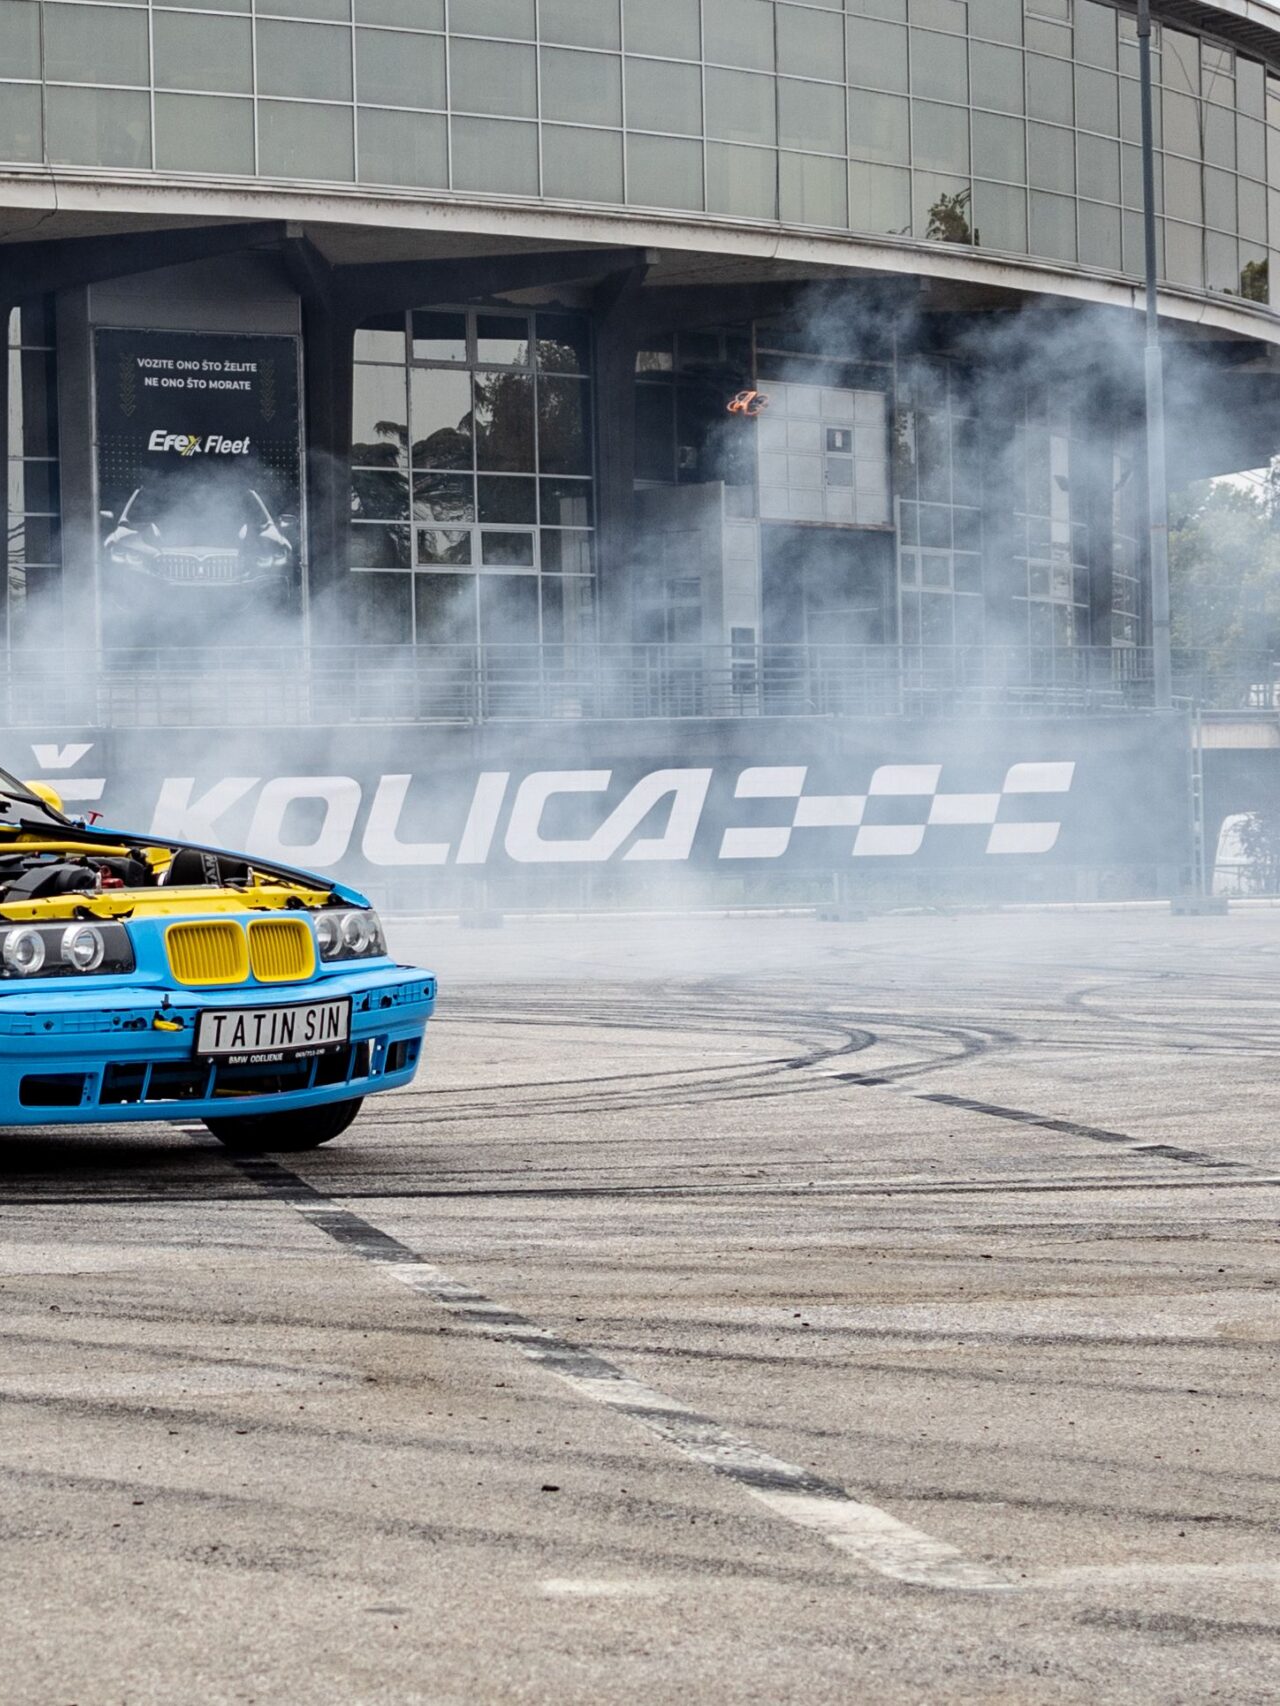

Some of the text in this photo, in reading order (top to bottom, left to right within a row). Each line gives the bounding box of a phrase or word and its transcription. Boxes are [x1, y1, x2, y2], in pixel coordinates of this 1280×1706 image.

[137, 358, 257, 373] VOZITE ONO ŠTO ŽELITE
[144, 376, 252, 390] NE ONO ŠTO MORATE
[204, 435, 251, 455] Fleet
[148, 768, 713, 867] KOLICA
[213, 1005, 341, 1048] TATIN SIN
[228, 1054, 248, 1064] BMW
